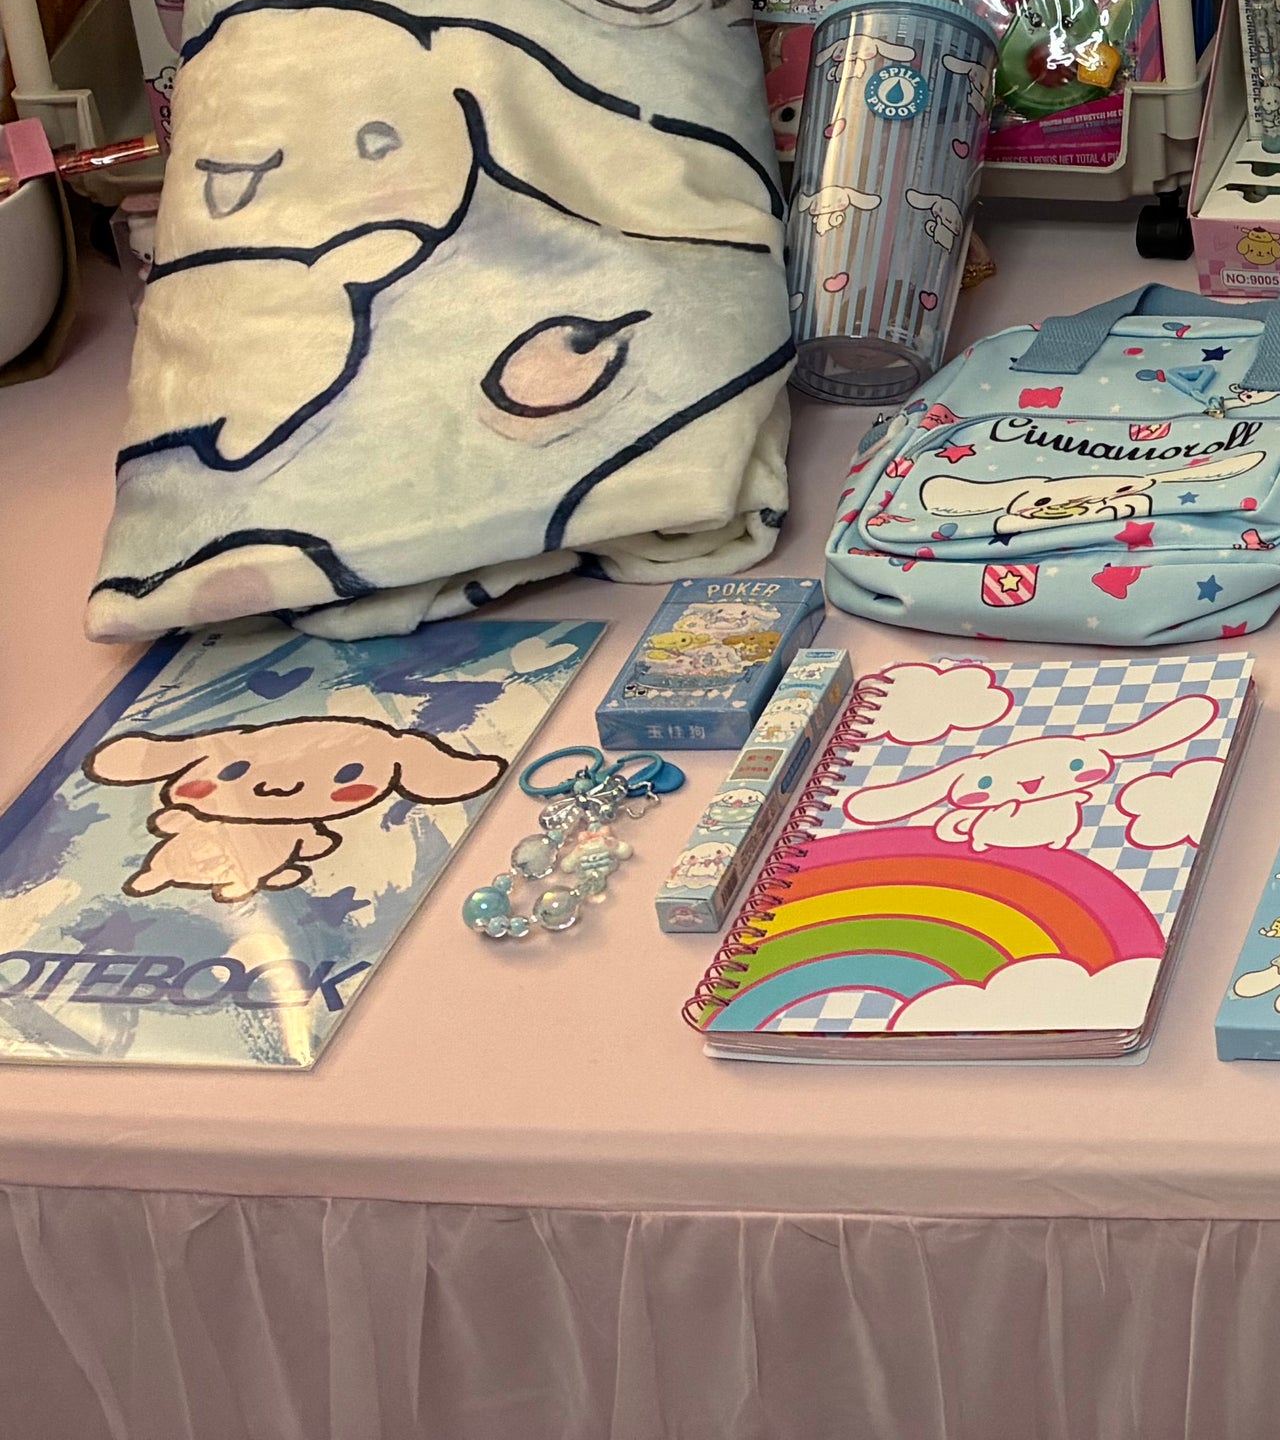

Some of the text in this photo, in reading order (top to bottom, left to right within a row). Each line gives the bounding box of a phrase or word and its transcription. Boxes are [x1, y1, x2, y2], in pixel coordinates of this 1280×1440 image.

[878, 66, 921, 89] SPILL
[868, 96, 919, 118] PROOF
[1225, 272, 1280, 287] NO:9005
[990, 417, 1263, 462] Cinnamoroll
[707, 582, 781, 598] POKER
[0, 949, 372, 1012] OTEBOOK
